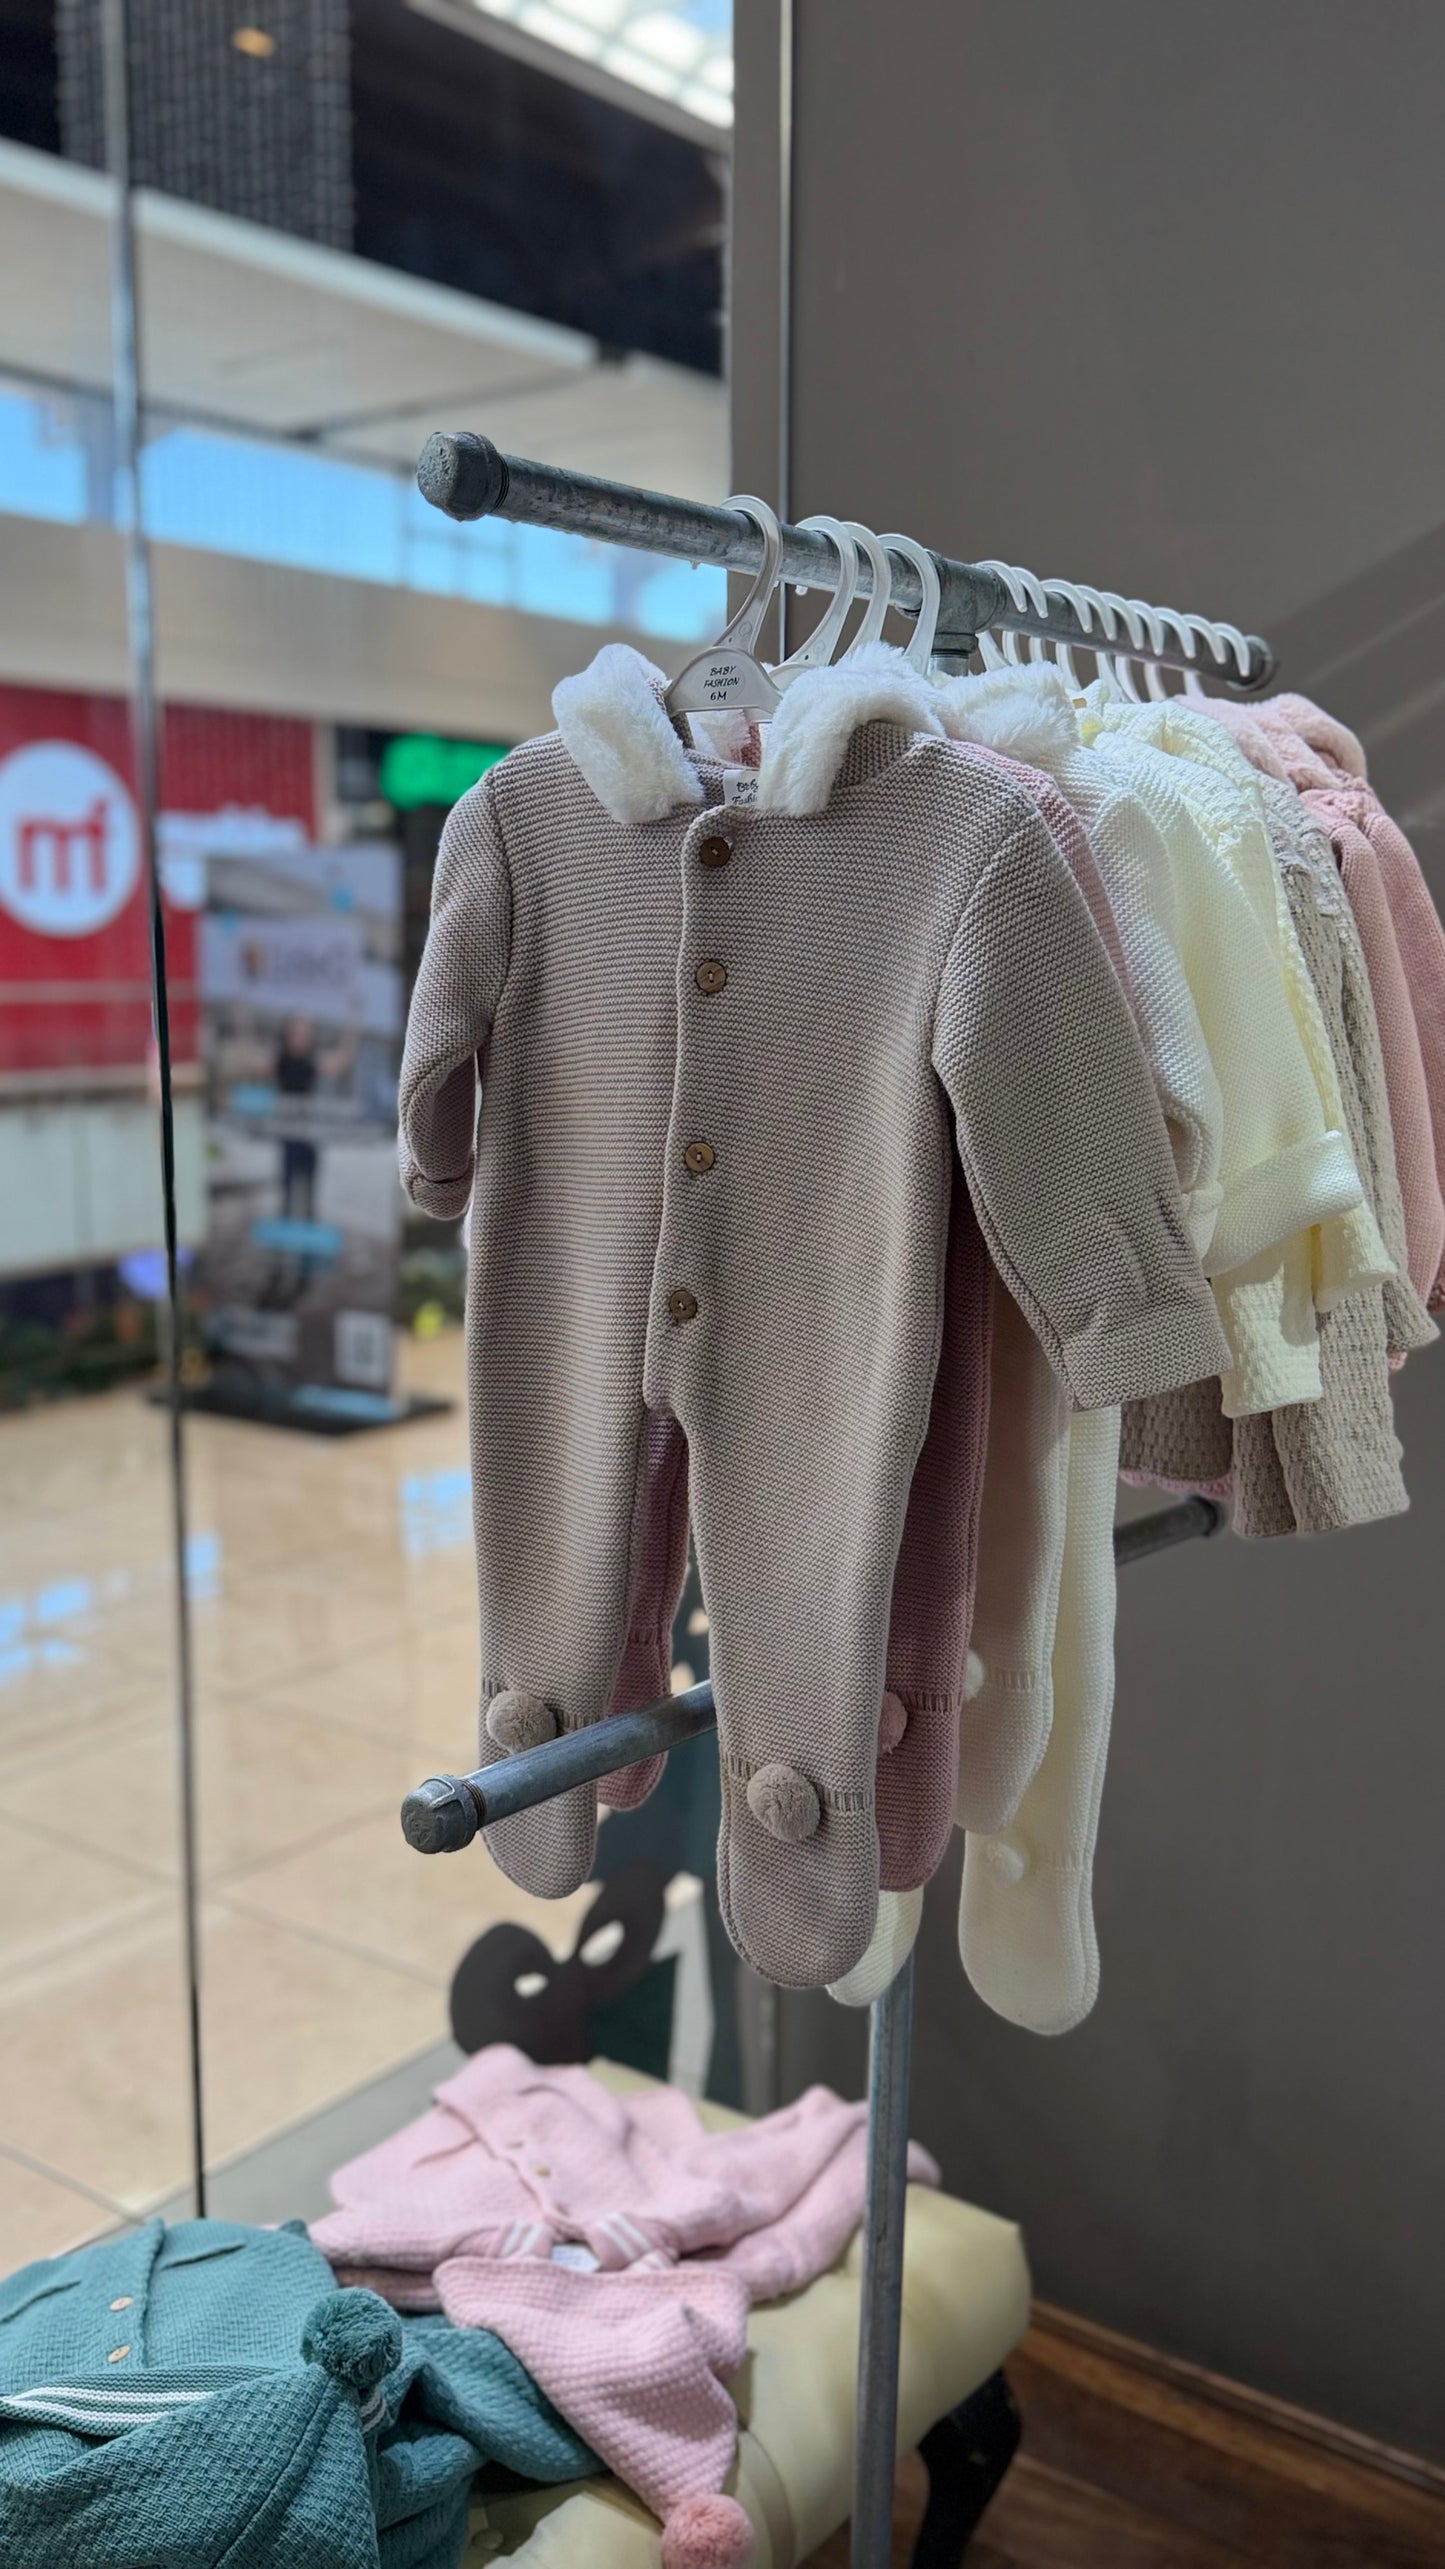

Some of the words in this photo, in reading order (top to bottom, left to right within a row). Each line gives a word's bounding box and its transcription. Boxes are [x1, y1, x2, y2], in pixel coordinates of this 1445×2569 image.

[710, 665, 737, 676] BABY
[703, 677, 740, 689] FASHION
[710, 691, 727, 701] 6M
[731, 793, 758, 805] Fashi
